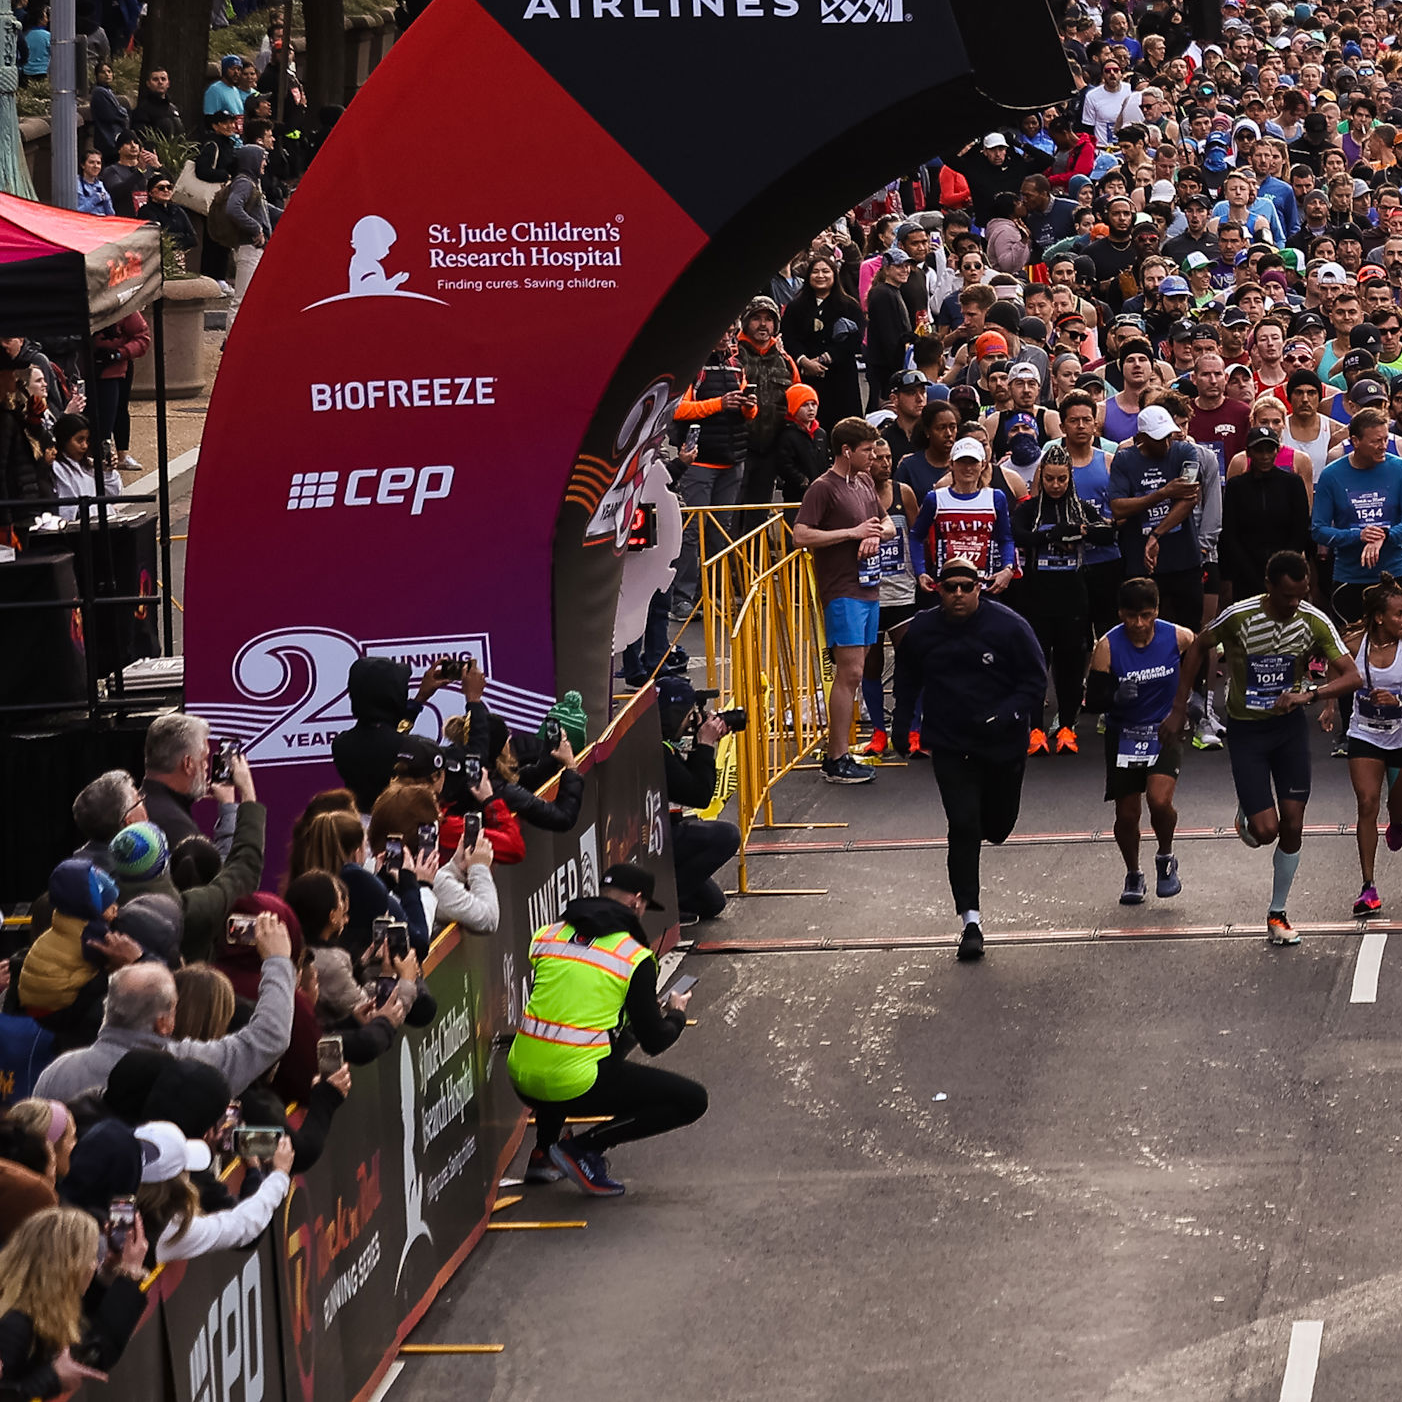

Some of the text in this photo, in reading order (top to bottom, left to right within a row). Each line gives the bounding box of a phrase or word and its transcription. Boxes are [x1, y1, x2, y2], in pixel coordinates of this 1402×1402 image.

[428, 222, 621, 247] St. Jude Children's
[429, 247, 622, 271] Research Hospital
[437, 278, 619, 292] Finding cures. Saving children.
[345, 464, 456, 516] cep
[1147, 506, 1170, 518] 1512
[1356, 508, 1383, 520] 1544
[392, 651, 473, 668] UNNING
[1126, 665, 1166, 678] COLORADO
[1256, 673, 1284, 684] 1014
[282, 731, 340, 748] YEAR
[1134, 741, 1149, 751] 49
[528, 857, 578, 936] UNITED
